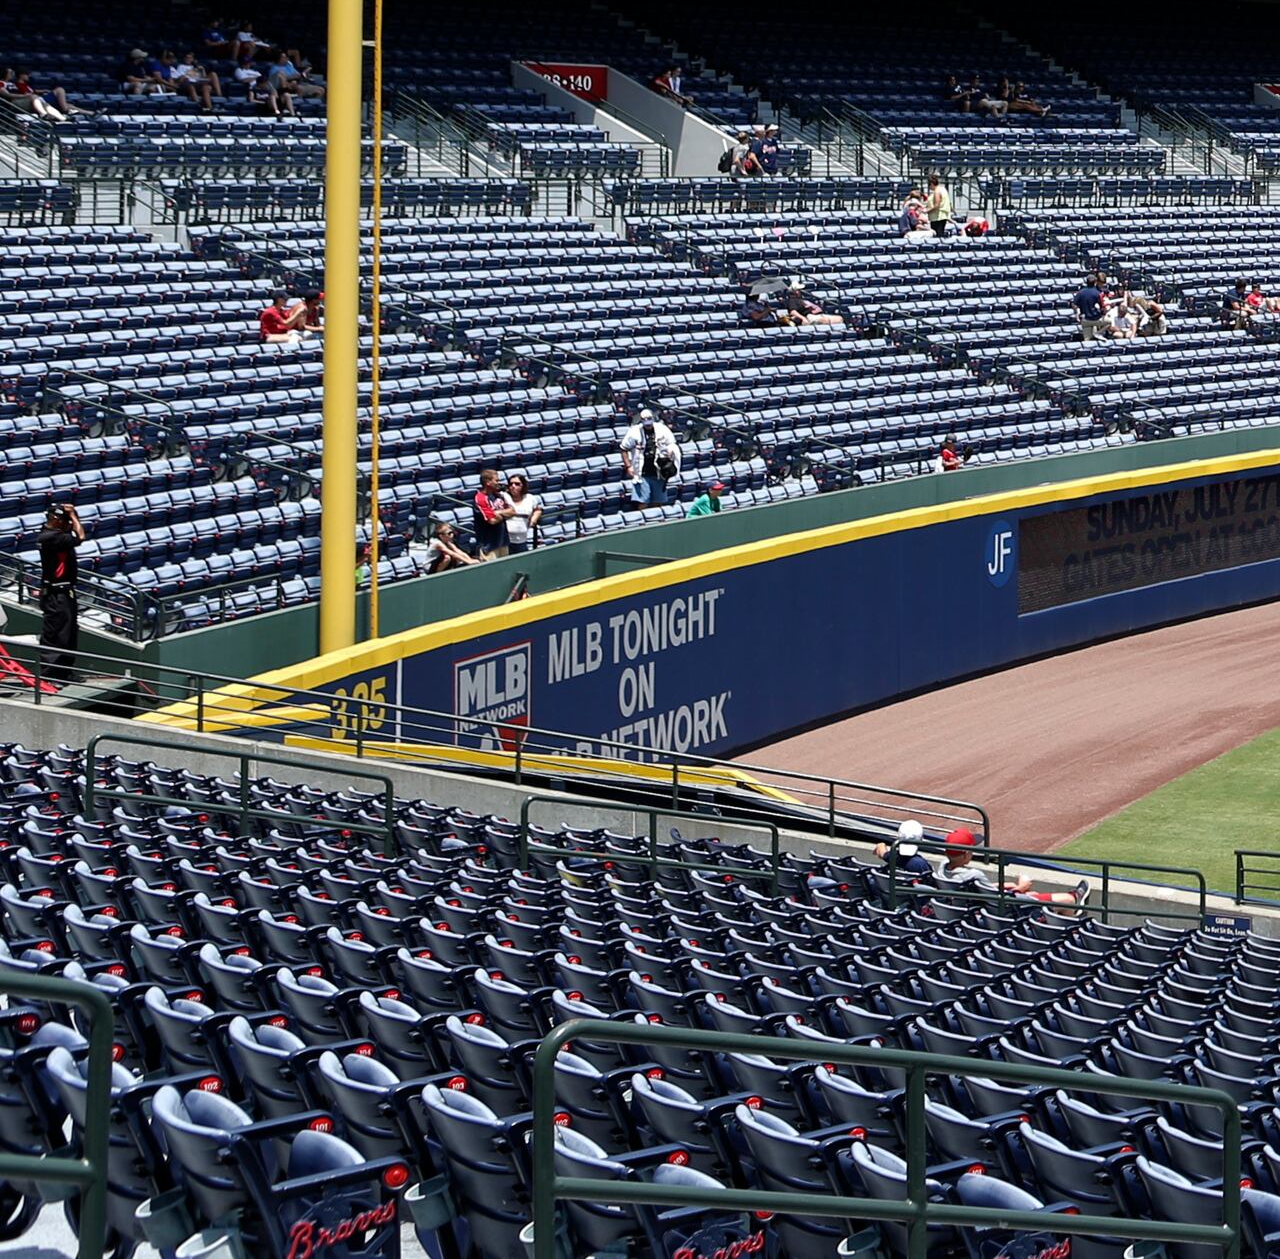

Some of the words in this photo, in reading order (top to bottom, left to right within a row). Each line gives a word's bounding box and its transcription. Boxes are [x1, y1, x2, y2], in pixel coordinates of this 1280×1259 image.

[1088, 490, 1180, 542] SUNDAY,
[1185, 481, 1238, 525] JULY
[988, 531, 1013, 576] JF
[548, 622, 603, 685] MLB
[609, 590, 719, 664] TONIGHT
[459, 652, 526, 716] MLB
[619, 662, 655, 719] ON
[457, 698, 526, 734] NETWORK
[600, 692, 728, 763] NETWORK
[204, 1081, 218, 1090] 102
[316, 1123, 329, 1132] 101
[287, 1199, 395, 1259] Braves
